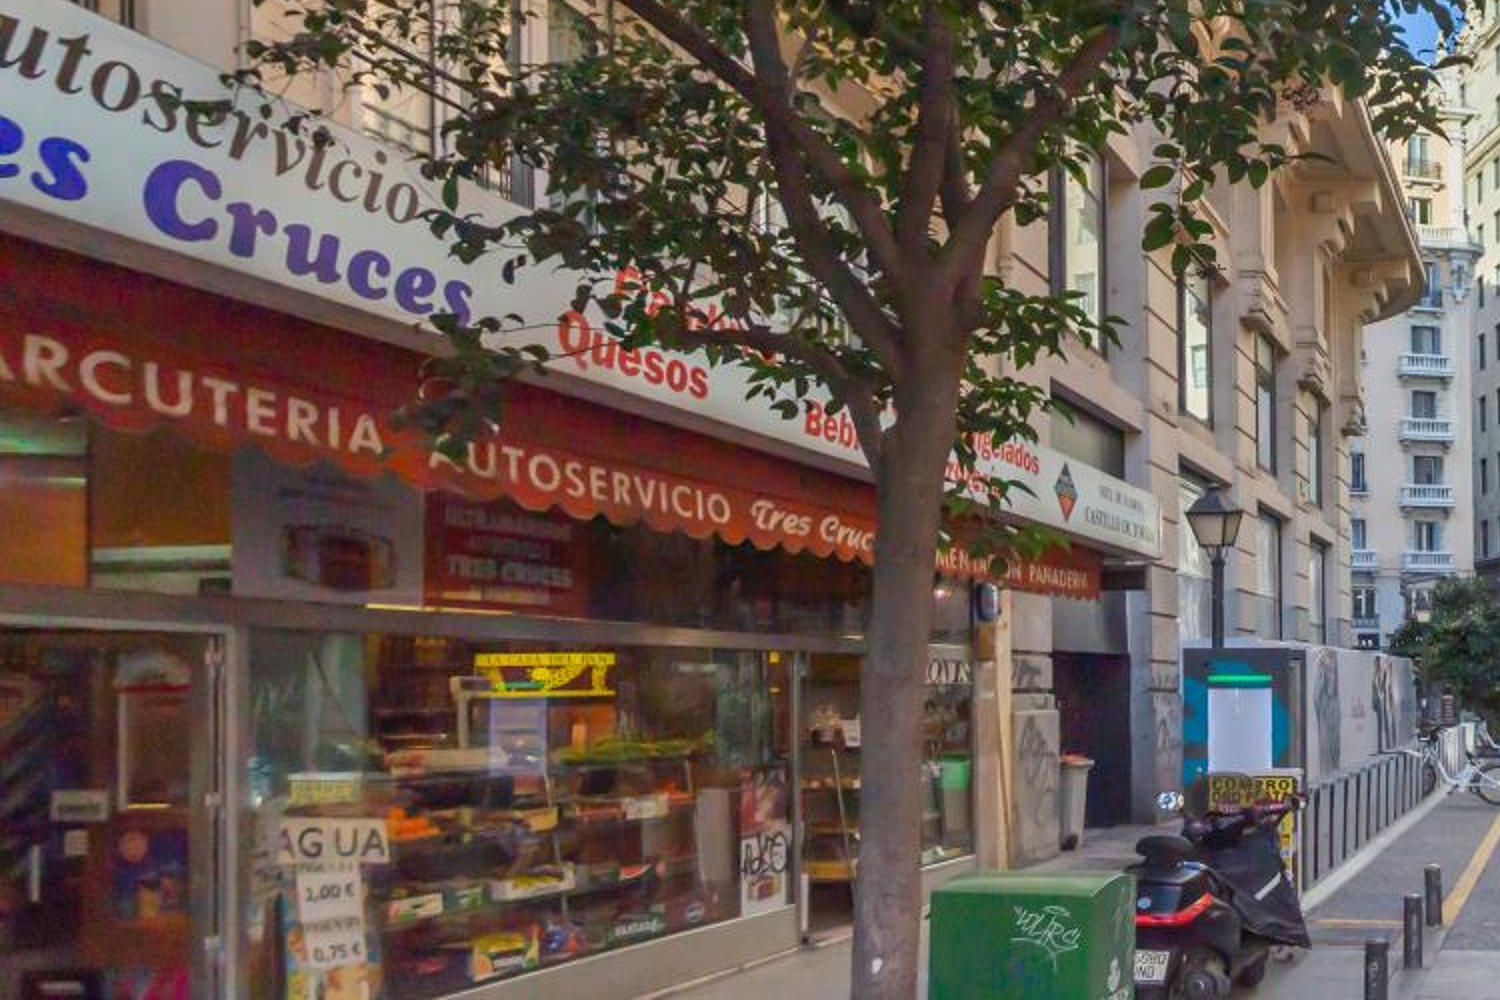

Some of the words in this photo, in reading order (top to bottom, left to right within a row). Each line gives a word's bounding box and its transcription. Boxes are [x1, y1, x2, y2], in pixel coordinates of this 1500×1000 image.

[143, 159, 472, 328] Cruces
[558, 311, 709, 400] Quesos
[751, 499, 811, 538] Tres
[279, 826, 386, 858] AGUA
